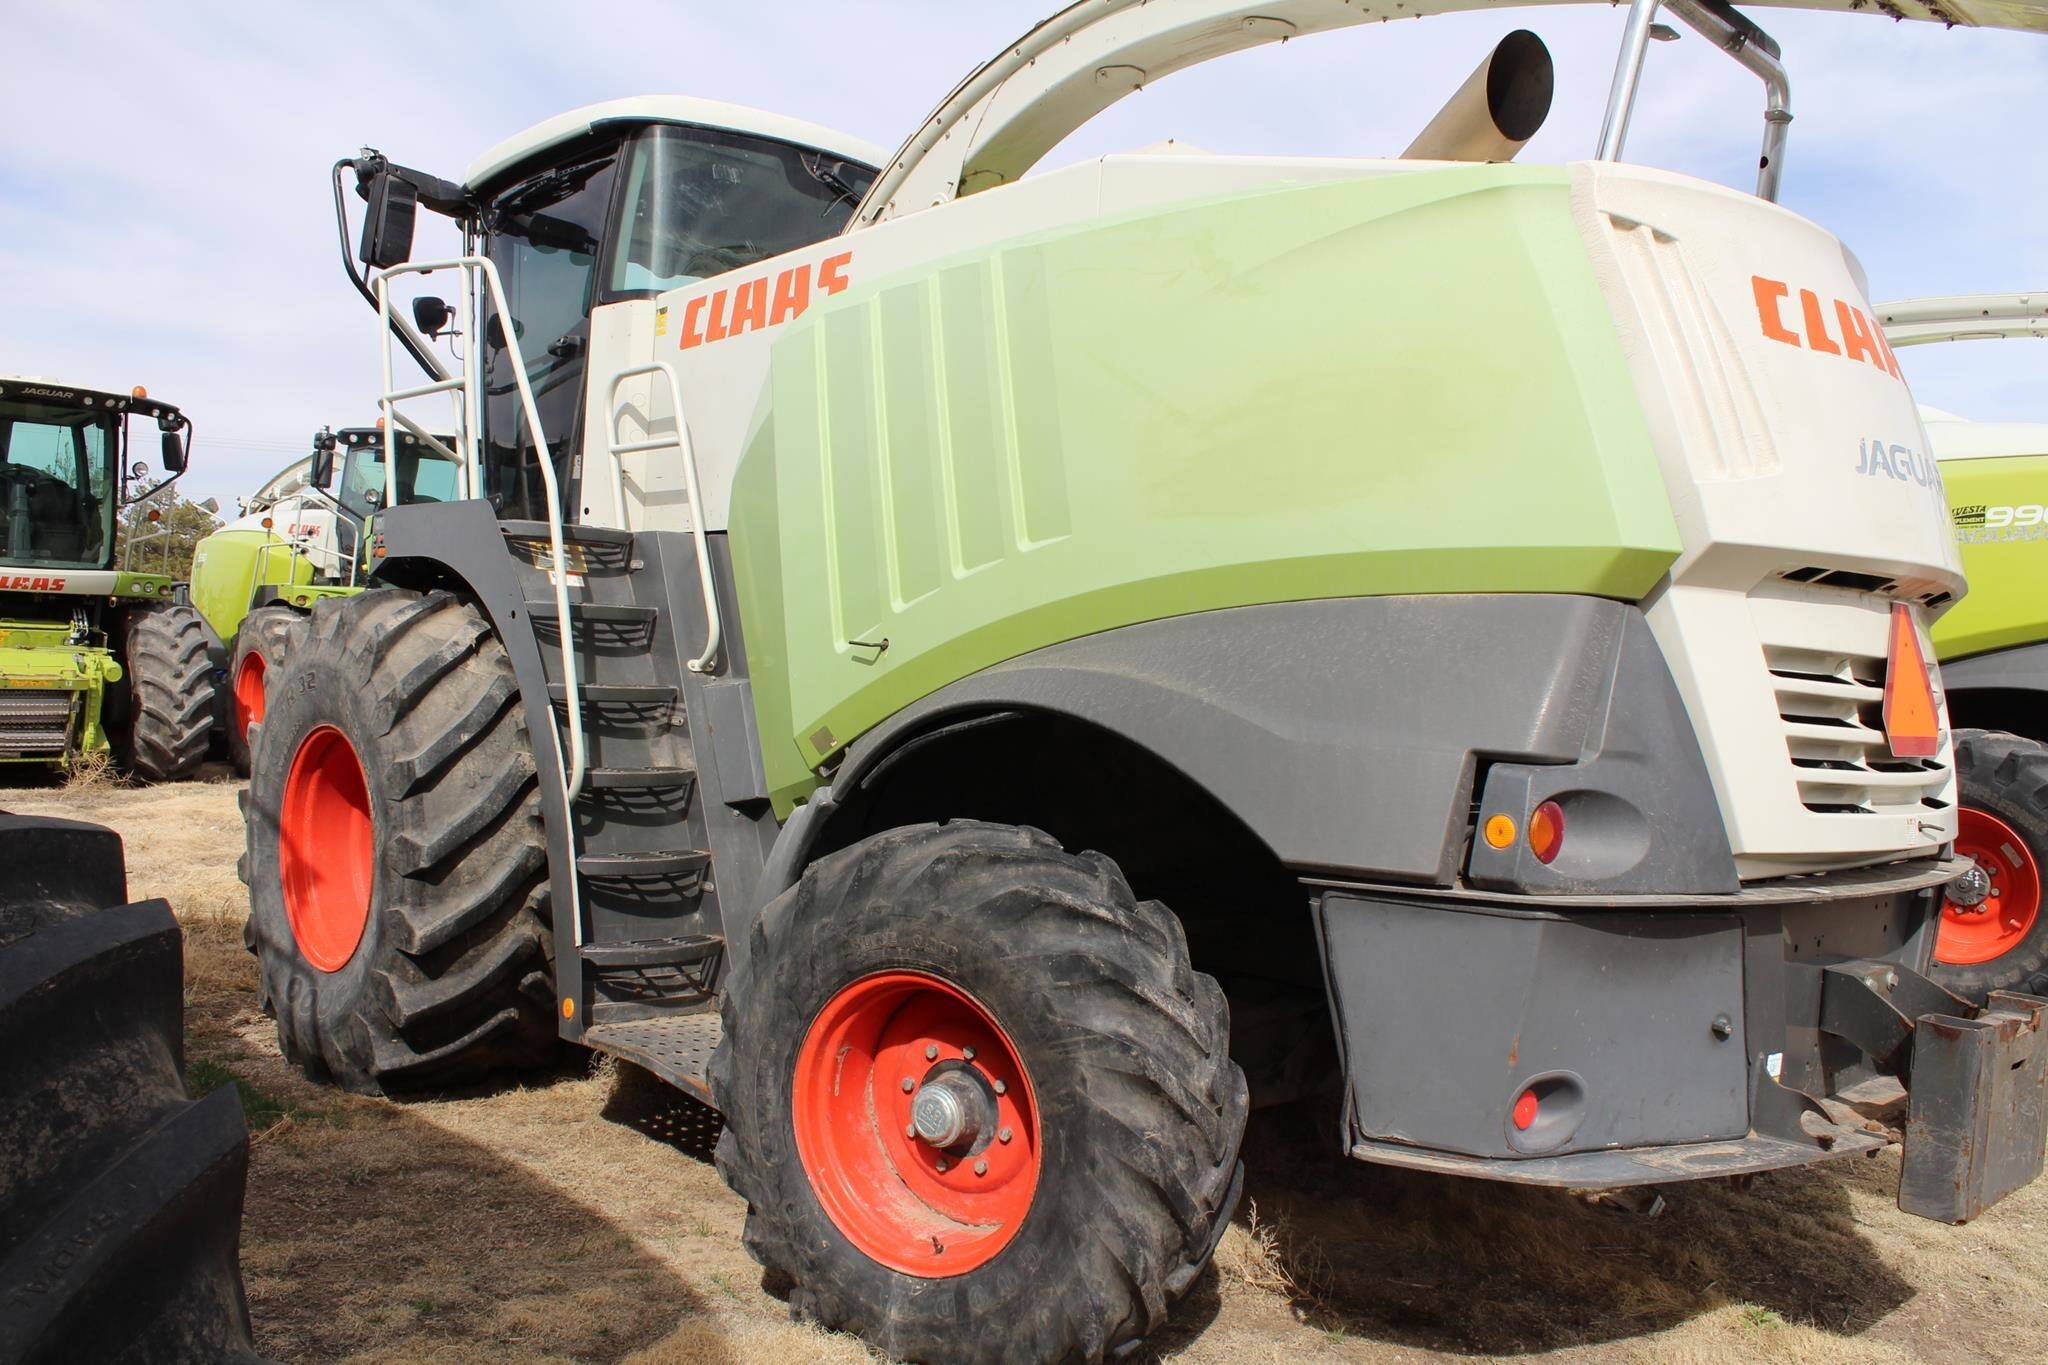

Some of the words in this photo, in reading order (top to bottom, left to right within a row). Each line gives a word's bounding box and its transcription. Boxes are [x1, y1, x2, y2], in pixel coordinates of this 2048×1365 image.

[680, 251, 852, 350] CLAAS
[1752, 275, 1907, 385] CLAA
[21, 387, 74, 399] JAGUAR
[1985, 504, 2048, 528] 99
[0, 576, 66, 591] LAAS
